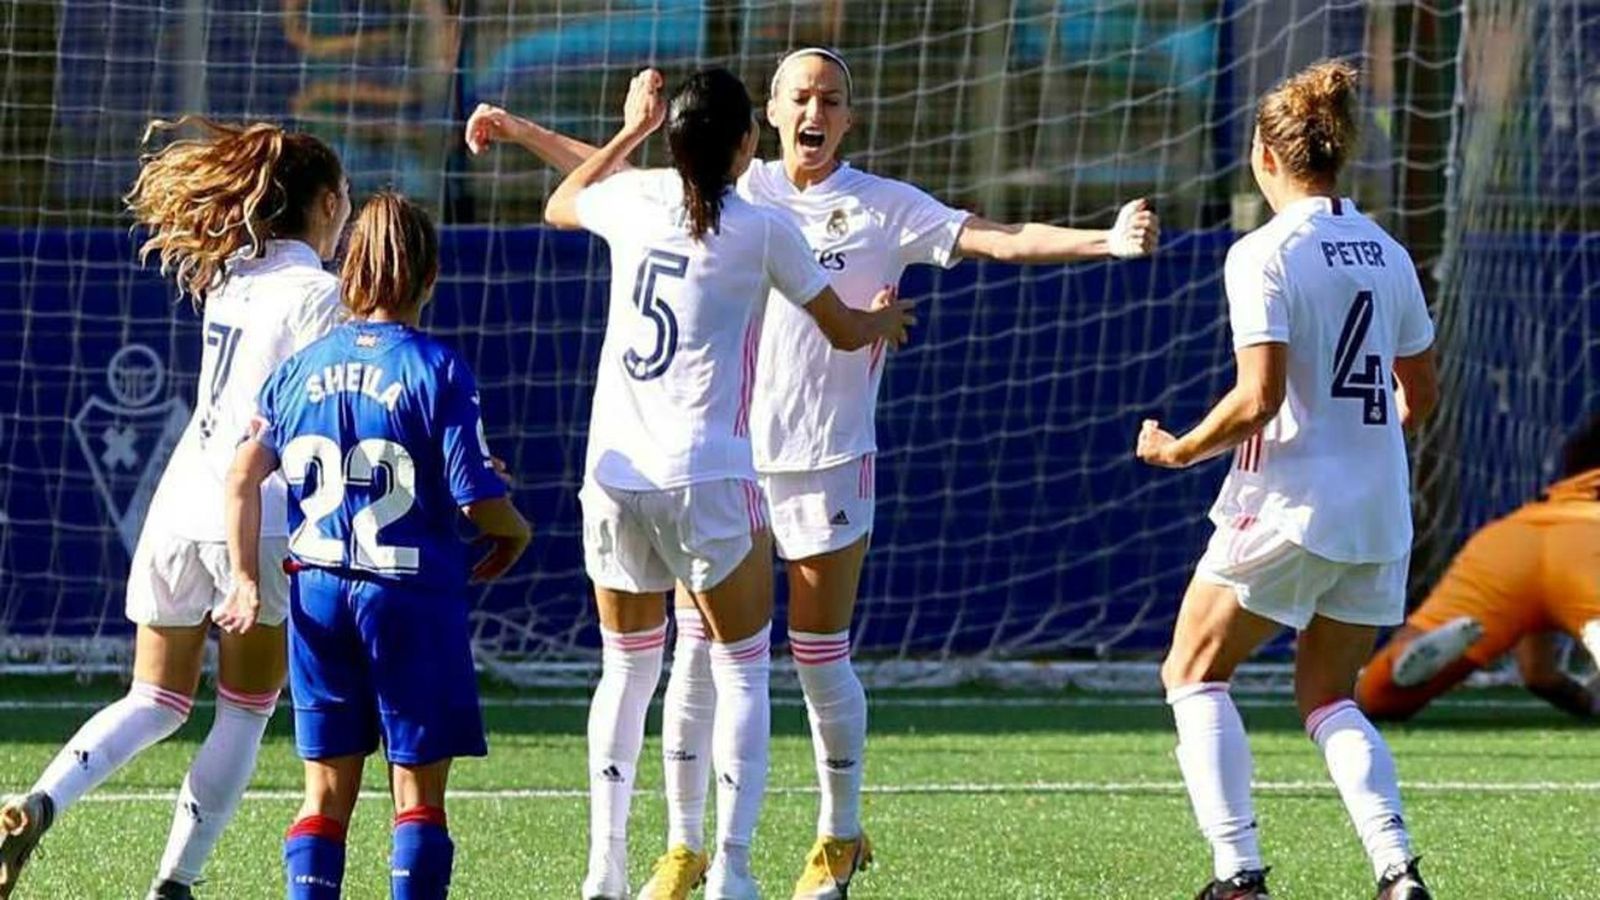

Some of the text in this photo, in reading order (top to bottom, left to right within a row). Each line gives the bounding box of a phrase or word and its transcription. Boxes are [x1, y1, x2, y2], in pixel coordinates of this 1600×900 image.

[623, 249, 690, 382] 5
[1321, 241, 1386, 267] PETER
[306, 363, 402, 411] SHEILA
[1331, 290, 1387, 425] 4
[281, 434, 419, 574] 22
